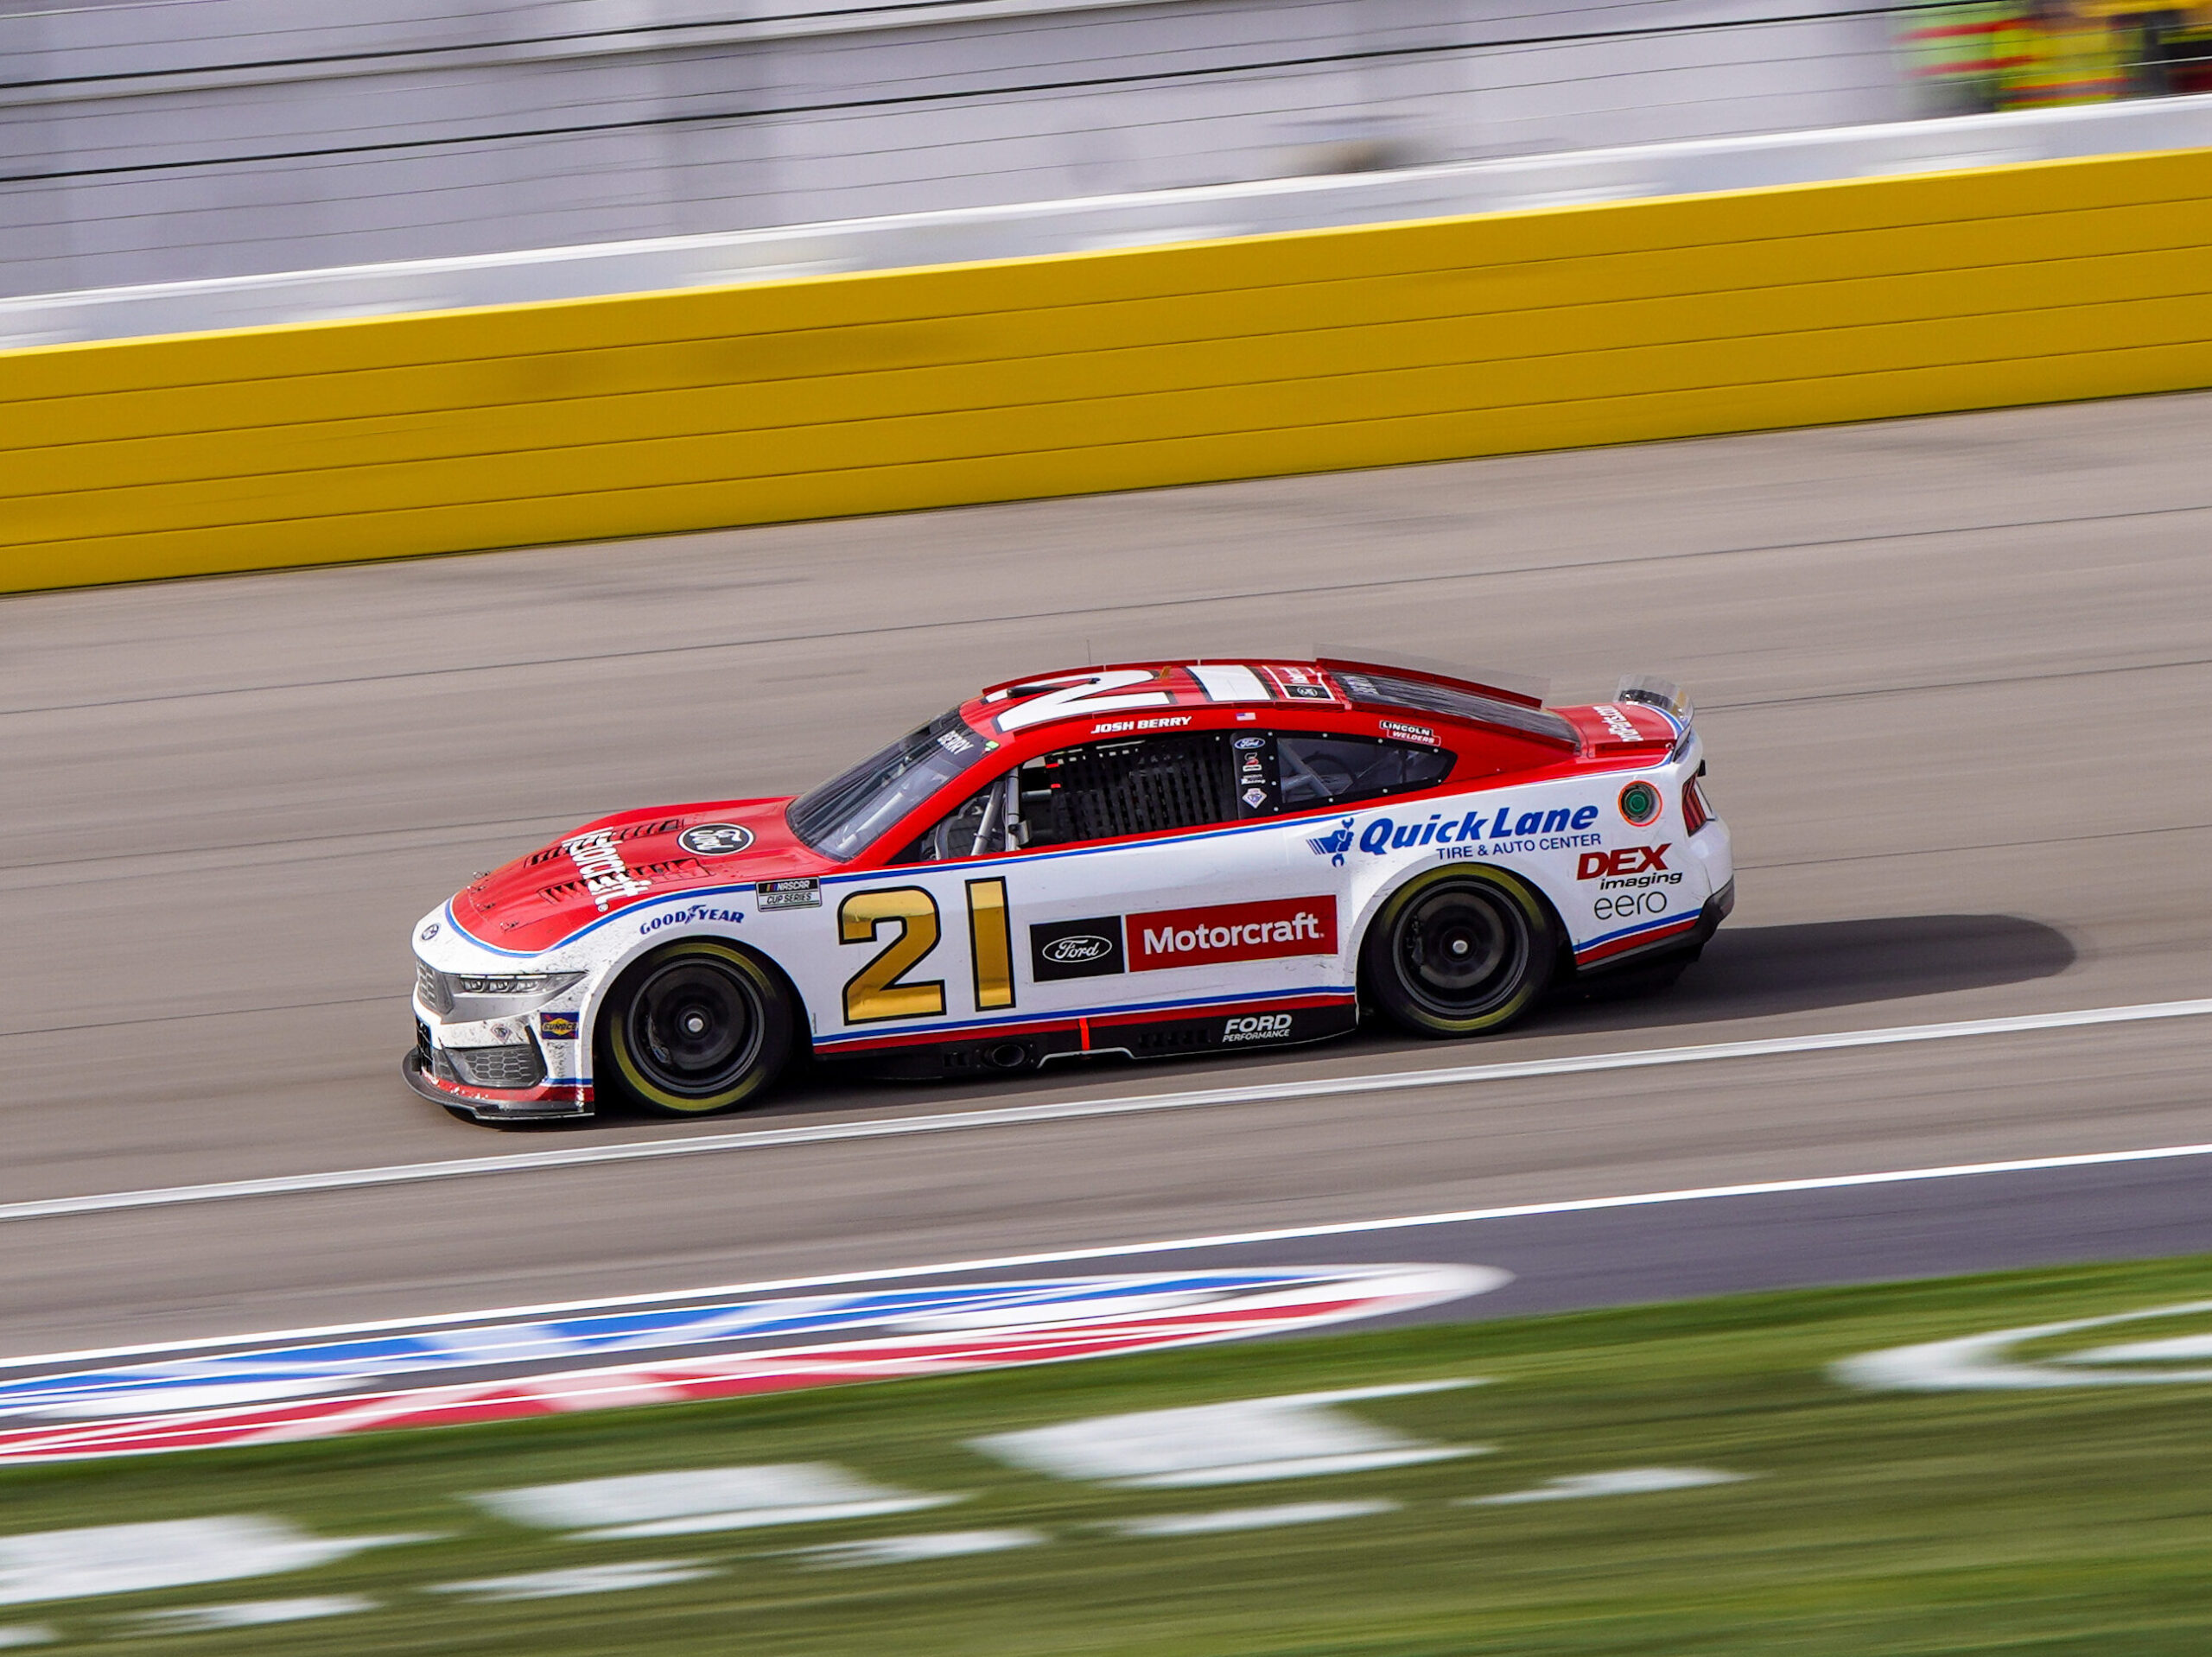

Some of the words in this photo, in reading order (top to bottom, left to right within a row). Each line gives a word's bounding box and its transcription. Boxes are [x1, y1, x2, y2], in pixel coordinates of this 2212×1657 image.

[1090, 721, 1135, 734] JOSH
[1137, 716, 1192, 729] BERRY
[1382, 721, 1431, 736] LINCOLN
[1392, 730, 1435, 744] WELDERS
[1436, 844, 1474, 860] TIRE
[1477, 843, 1490, 857] &
[1492, 839, 1535, 855] AUTO
[1540, 833, 1602, 849] CENTER
[1576, 842, 1673, 880] DEX
[777, 879, 810, 892] NASCAR
[1599, 872, 1683, 891] imaging
[766, 894, 783, 905] CUP
[784, 892, 812, 903] SERIES
[1594, 891, 1668, 920] eero
[639, 904, 745, 936] GOODYEAR
[836, 875, 1016, 1026] 21
[1055, 938, 1100, 959] Ford
[543, 1022, 577, 1031] SUNOCO
[1224, 1013, 1293, 1035] FORD
[1222, 1028, 1291, 1043] PERFORMANCE
